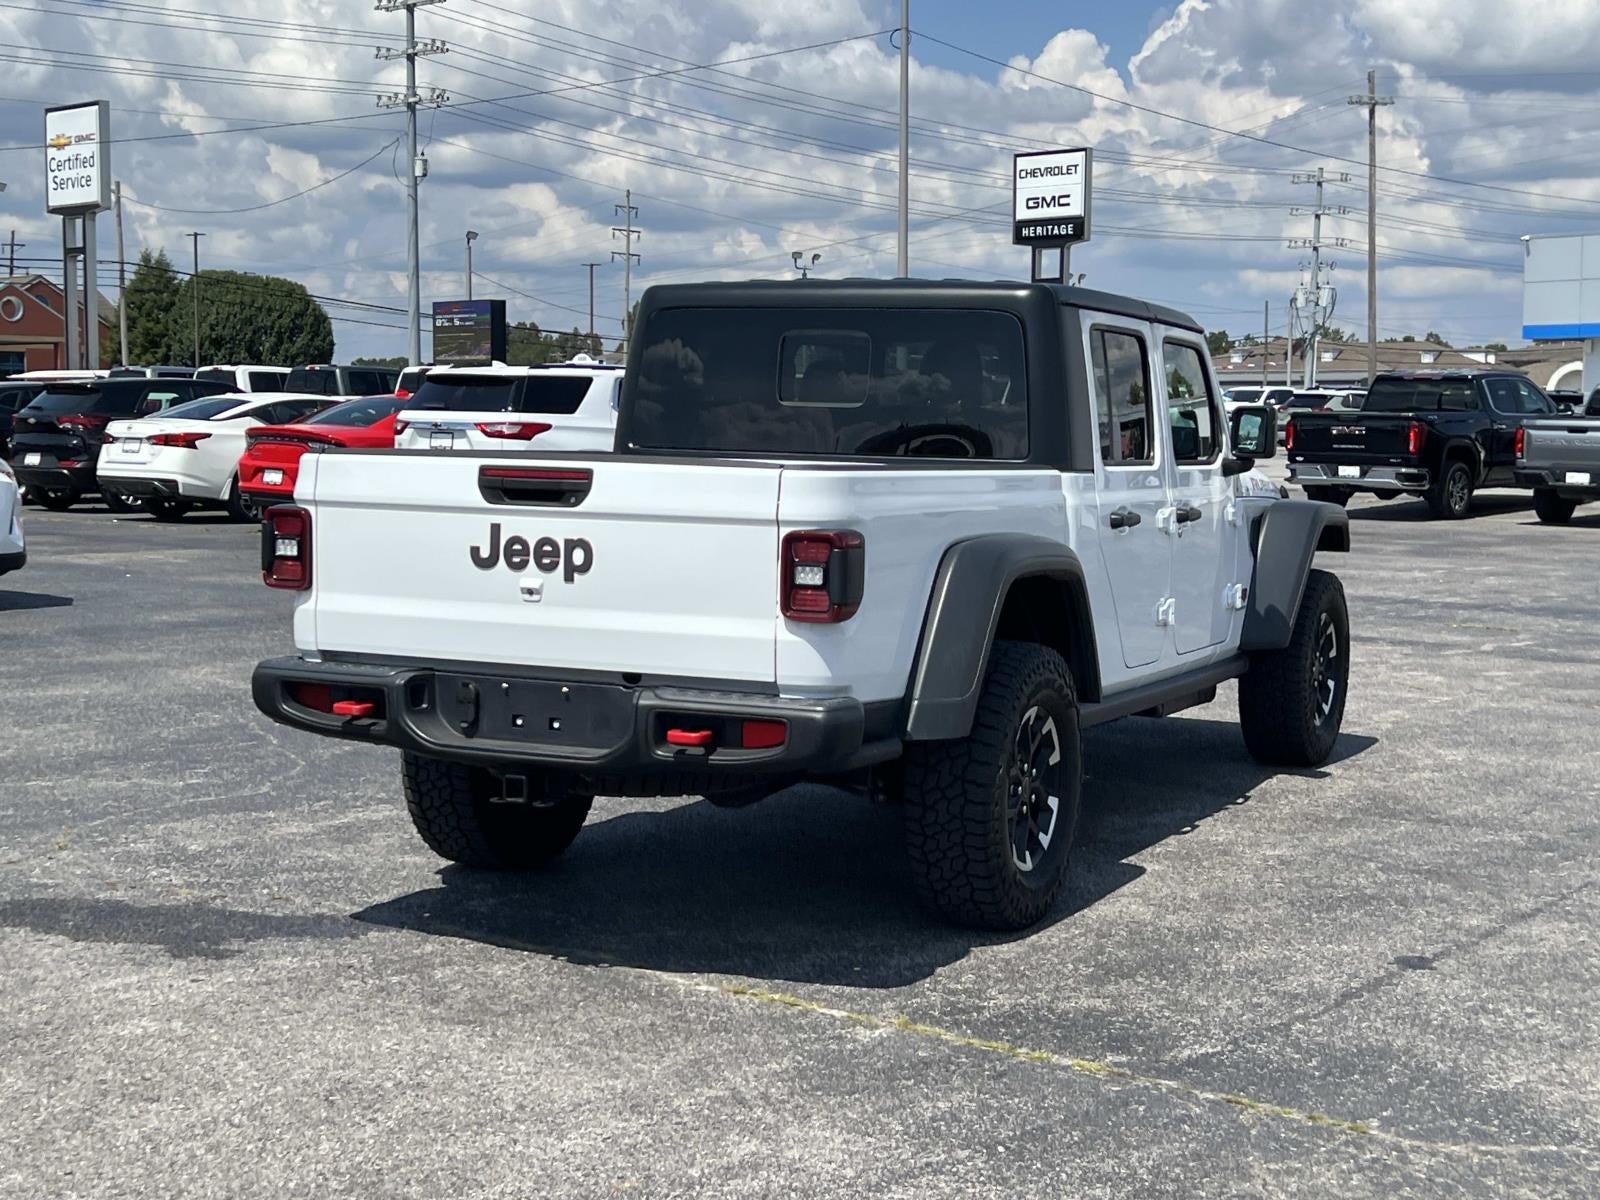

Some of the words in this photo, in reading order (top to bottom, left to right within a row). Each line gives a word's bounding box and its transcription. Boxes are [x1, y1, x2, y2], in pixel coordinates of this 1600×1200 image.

[74, 133, 95, 143] GMC
[49, 152, 95, 173] Certified
[1019, 164, 1079, 179] CHEVROLET
[52, 173, 92, 191] Service
[1026, 194, 1071, 210] GMC
[1022, 223, 1074, 237] HERITAGE
[470, 523, 593, 584] Jeep
